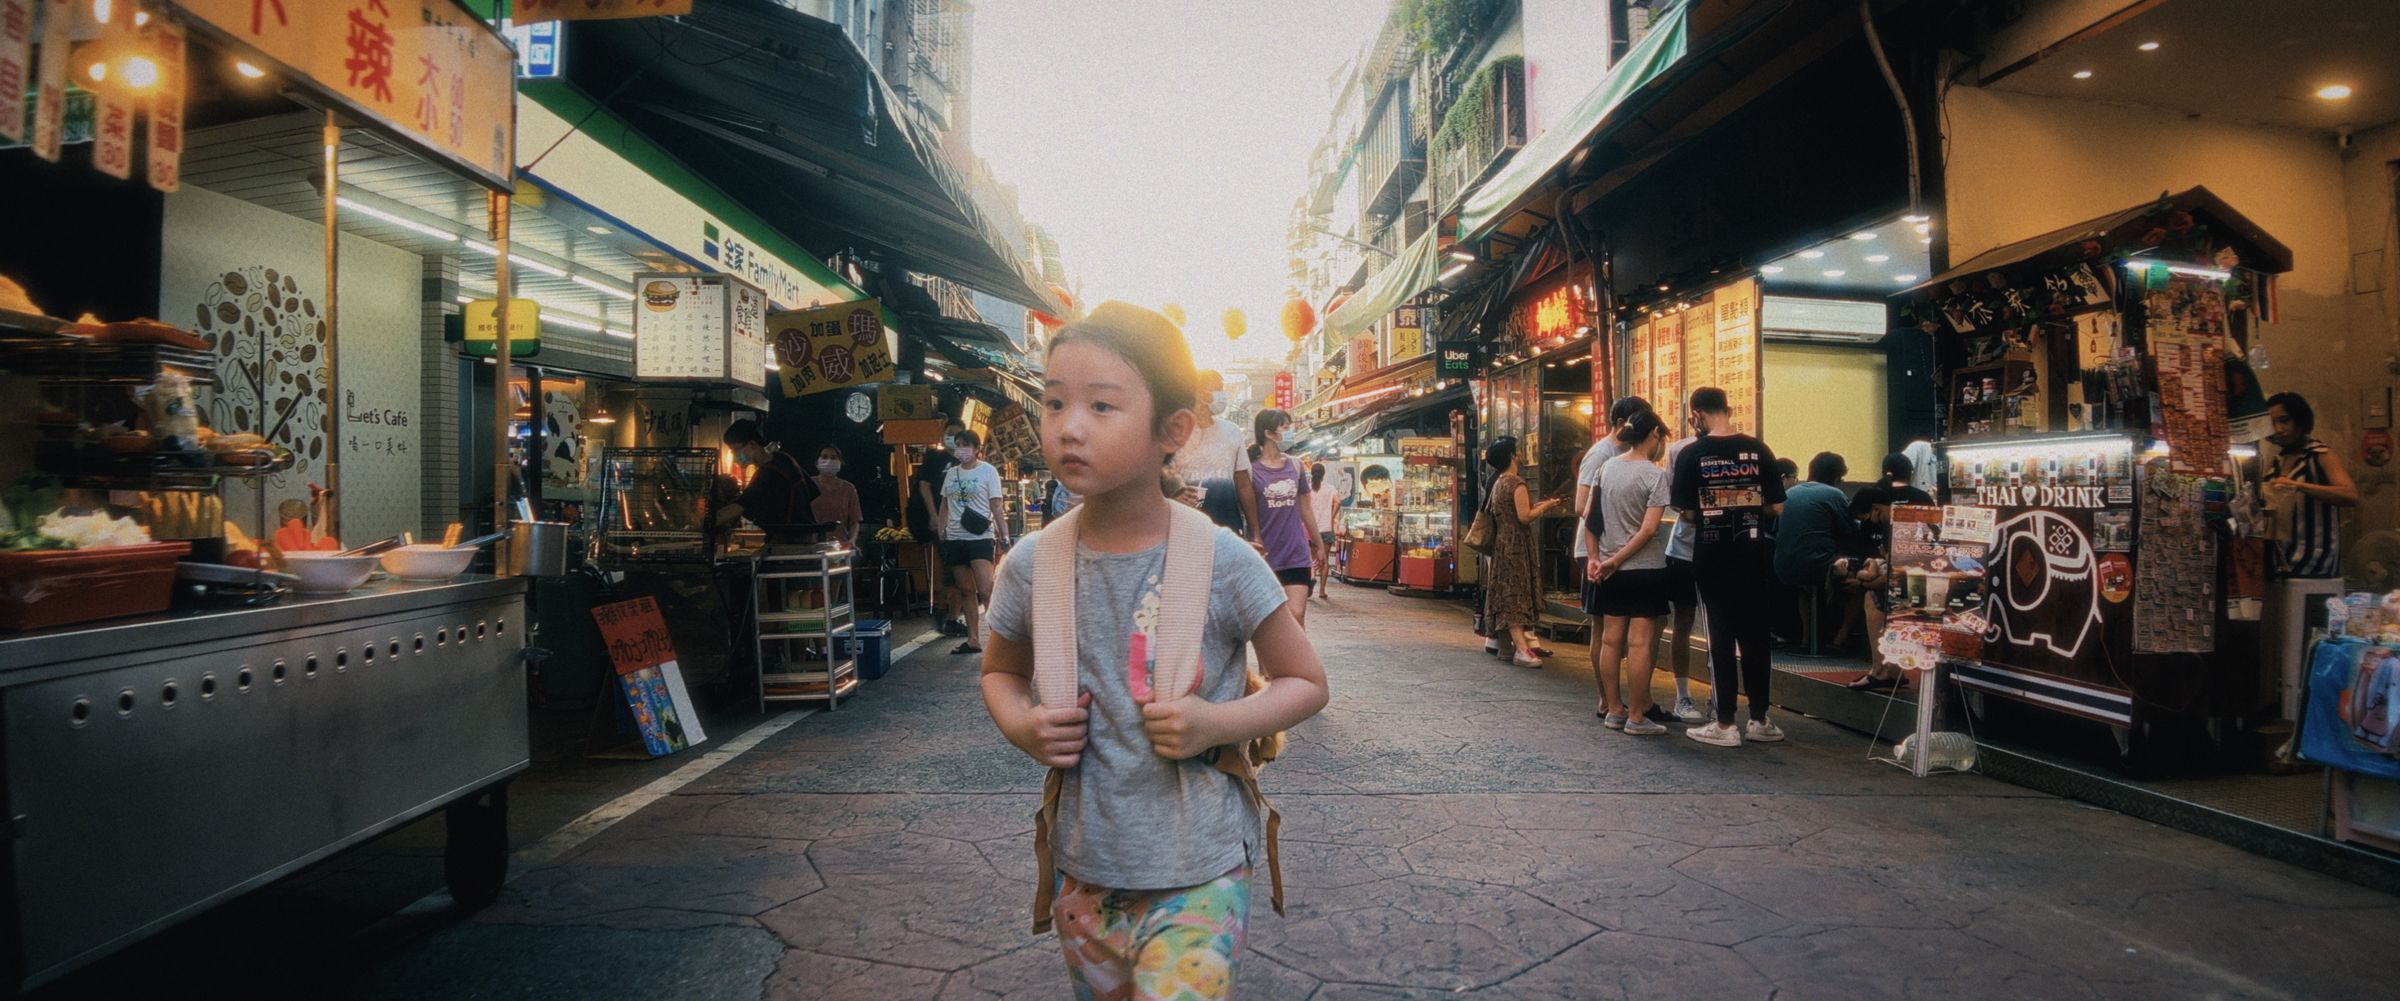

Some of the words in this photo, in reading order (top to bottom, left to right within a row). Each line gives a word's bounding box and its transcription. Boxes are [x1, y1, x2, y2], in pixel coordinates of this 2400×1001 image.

[345, 8, 393, 102] 辣
[724, 237, 744, 273] 全家
[748, 250, 800, 305] FamilyMart
[809, 320, 842, 338] 加蛋
[778, 332, 807, 366] 沙
[821, 348, 853, 380] 威
[848, 313, 878, 345] 瑪
[1444, 350, 1469, 361] Uber
[858, 349, 892, 379] 加起士
[1445, 360, 1469, 370] Eats
[790, 365, 816, 394] 加肉
[384, 409, 408, 427] Café
[1702, 464, 1759, 478] SEASON
[1268, 499, 1295, 509] Roots
[1976, 486, 2017, 507] THAI
[2040, 486, 2105, 508] DRINK
